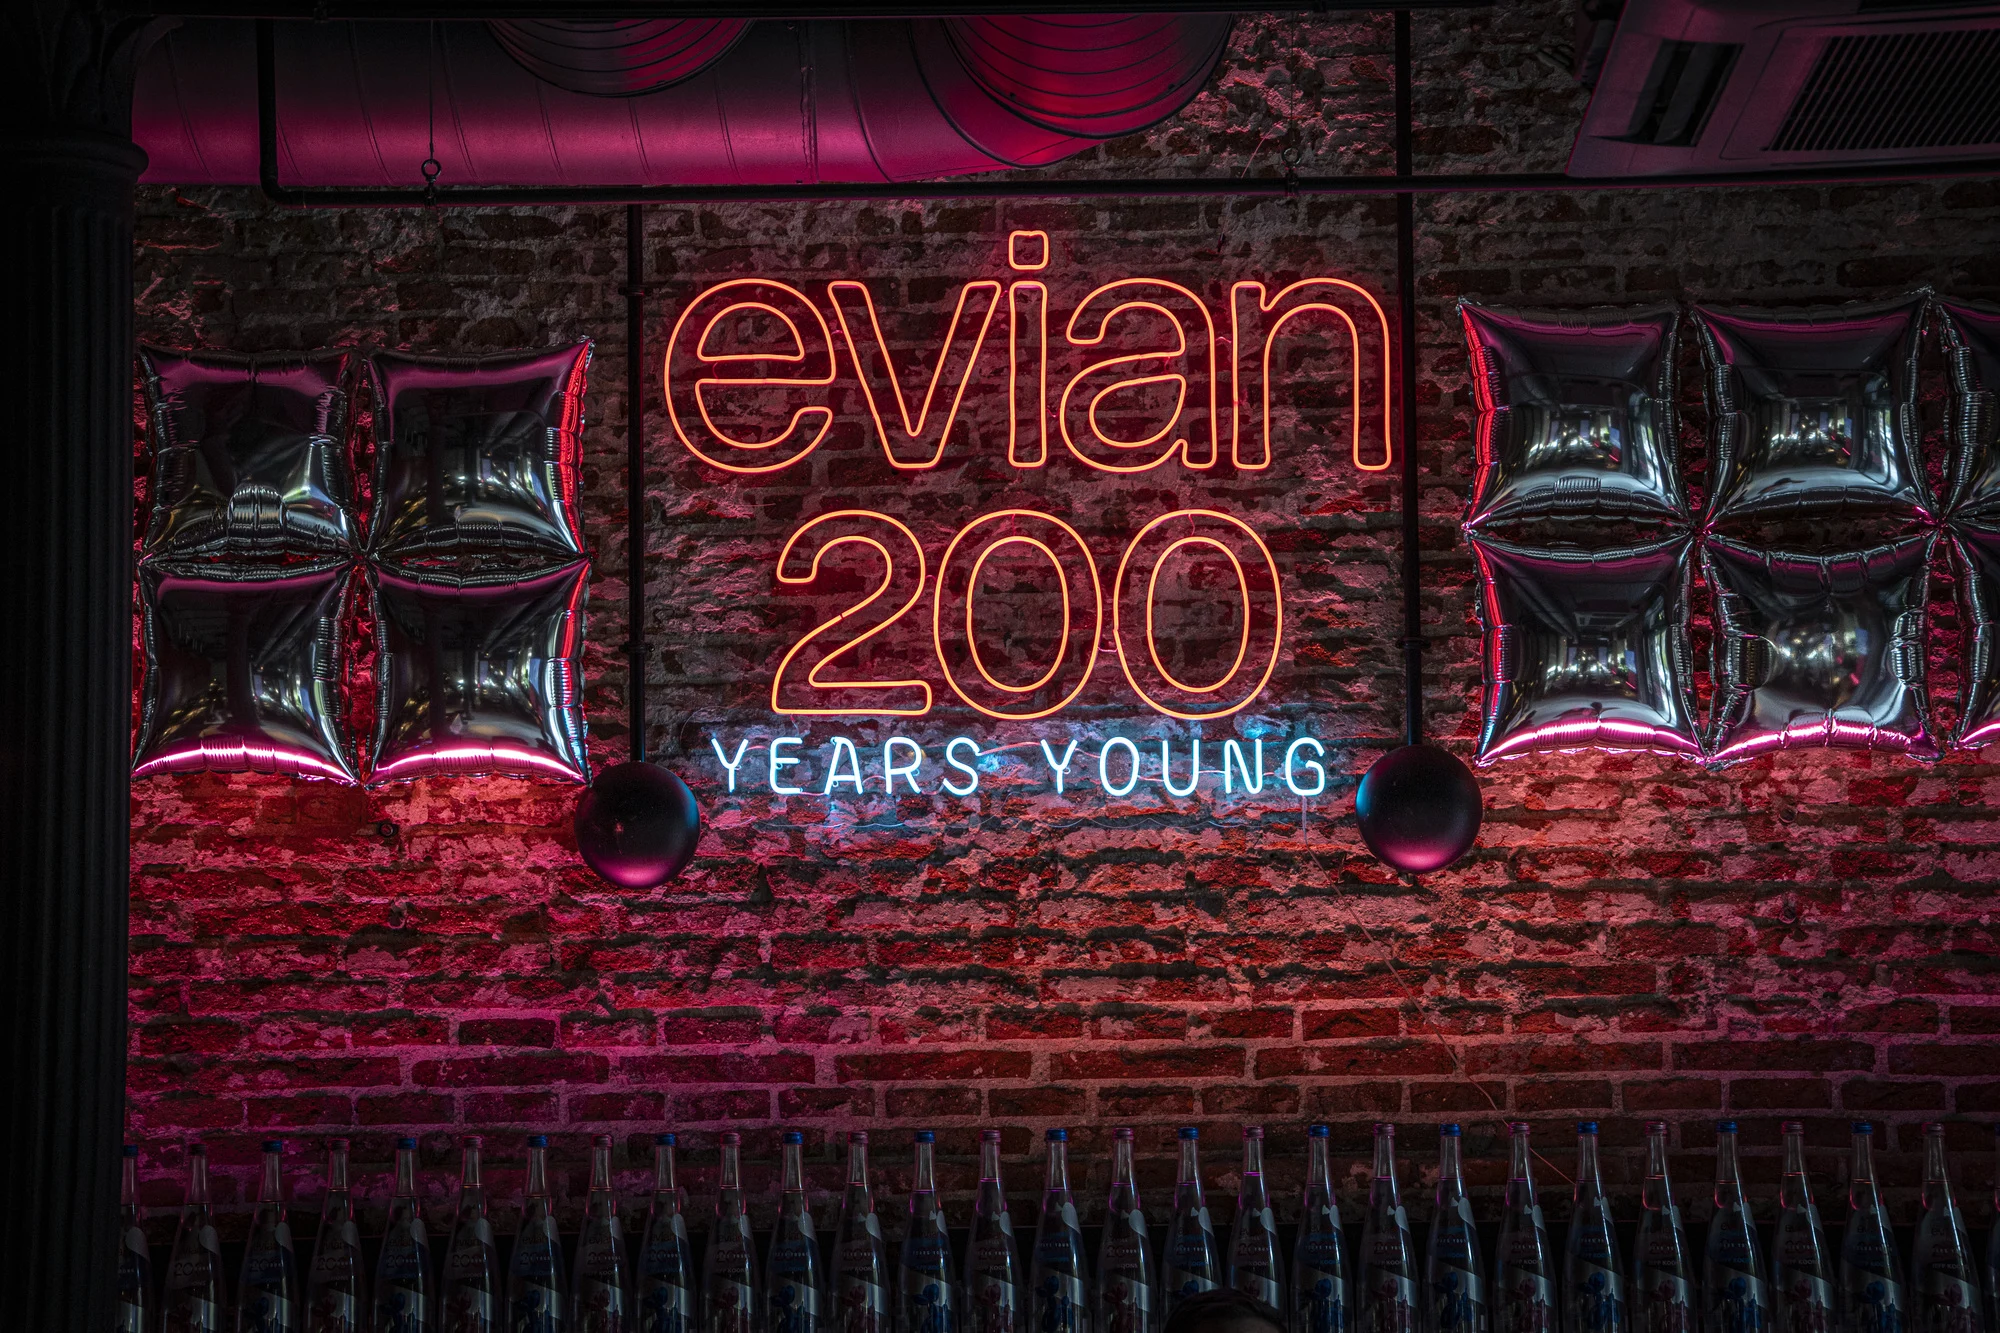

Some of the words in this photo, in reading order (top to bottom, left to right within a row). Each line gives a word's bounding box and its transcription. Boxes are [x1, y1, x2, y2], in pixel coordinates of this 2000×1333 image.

[664, 230, 1393, 473] evian
[771, 508, 1284, 721] 200
[710, 735, 982, 797] YEARS
[1039, 735, 1327, 798] YOUNG
